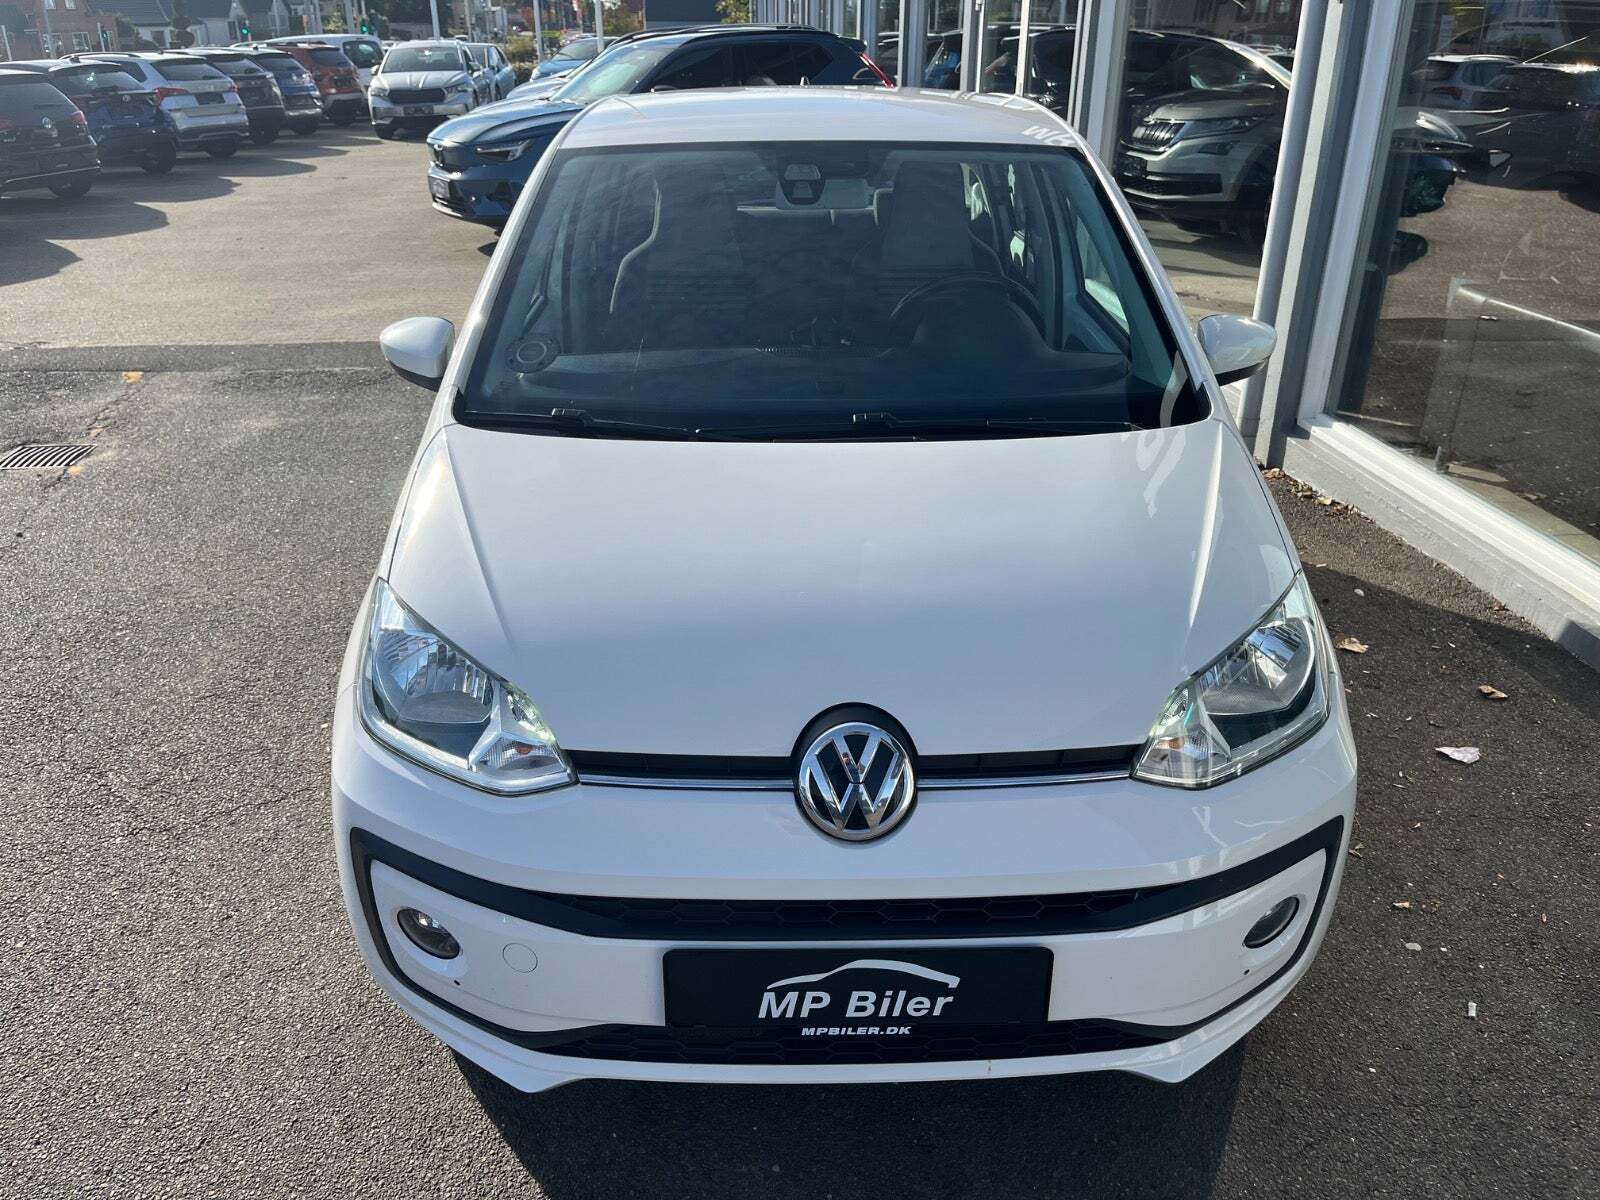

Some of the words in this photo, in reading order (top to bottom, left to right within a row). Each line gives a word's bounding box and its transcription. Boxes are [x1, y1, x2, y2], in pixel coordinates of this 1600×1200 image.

[758, 991, 831, 1019] MP
[845, 990, 954, 1018] Biler
[801, 1026, 912, 1036] MPBILER.DK
